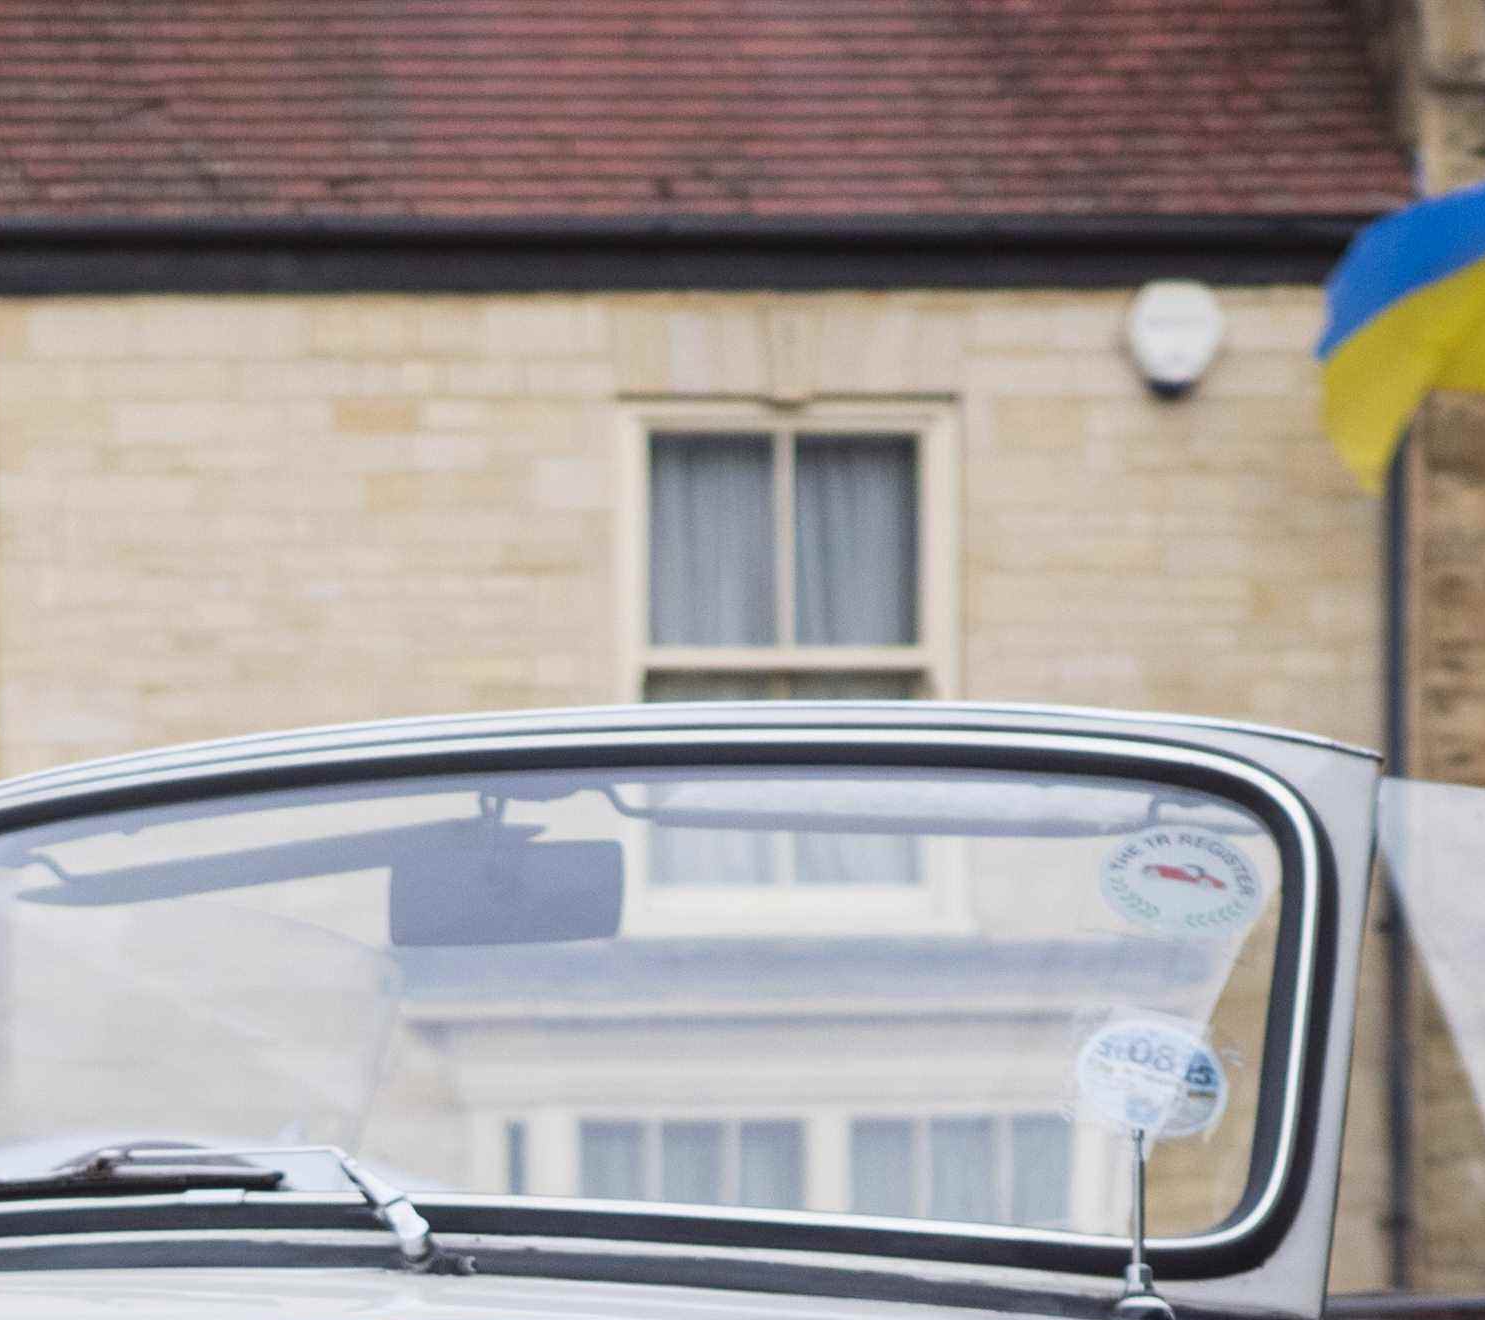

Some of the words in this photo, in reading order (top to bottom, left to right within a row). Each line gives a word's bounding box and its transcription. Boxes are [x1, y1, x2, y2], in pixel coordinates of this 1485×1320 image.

[1110, 845, 1143, 871] THE
[1143, 833, 1171, 849] TR
[1178, 833, 1256, 898] REGISTER
